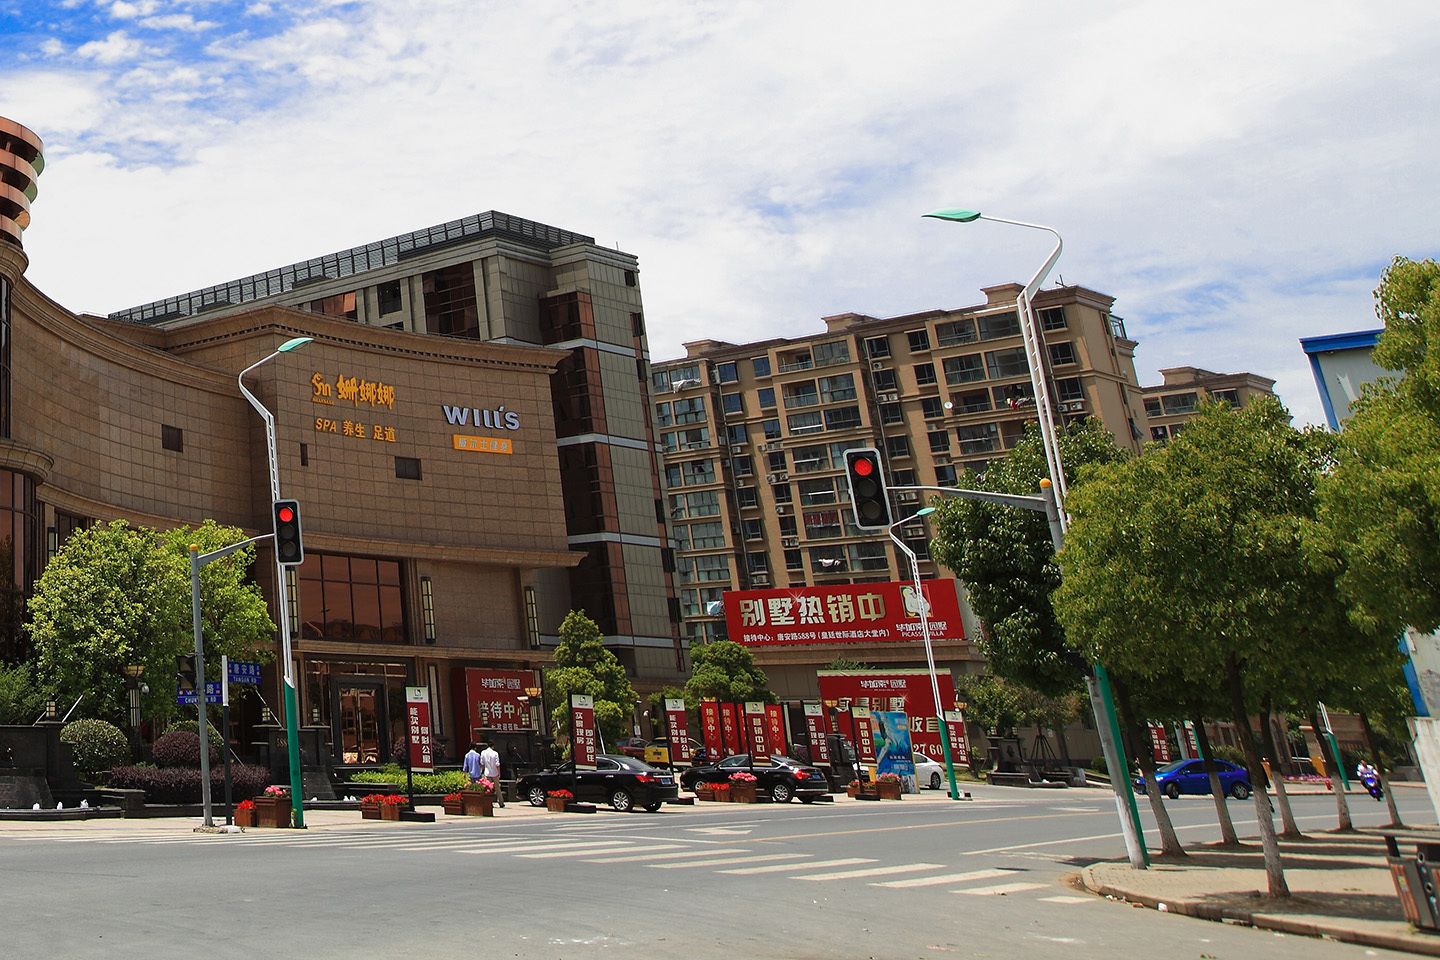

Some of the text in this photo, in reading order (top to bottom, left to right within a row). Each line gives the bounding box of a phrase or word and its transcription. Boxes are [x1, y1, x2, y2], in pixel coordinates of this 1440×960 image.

[315, 418, 397, 442] SPA 养生 足道
[740, 592, 887, 627] 别墅热销中
